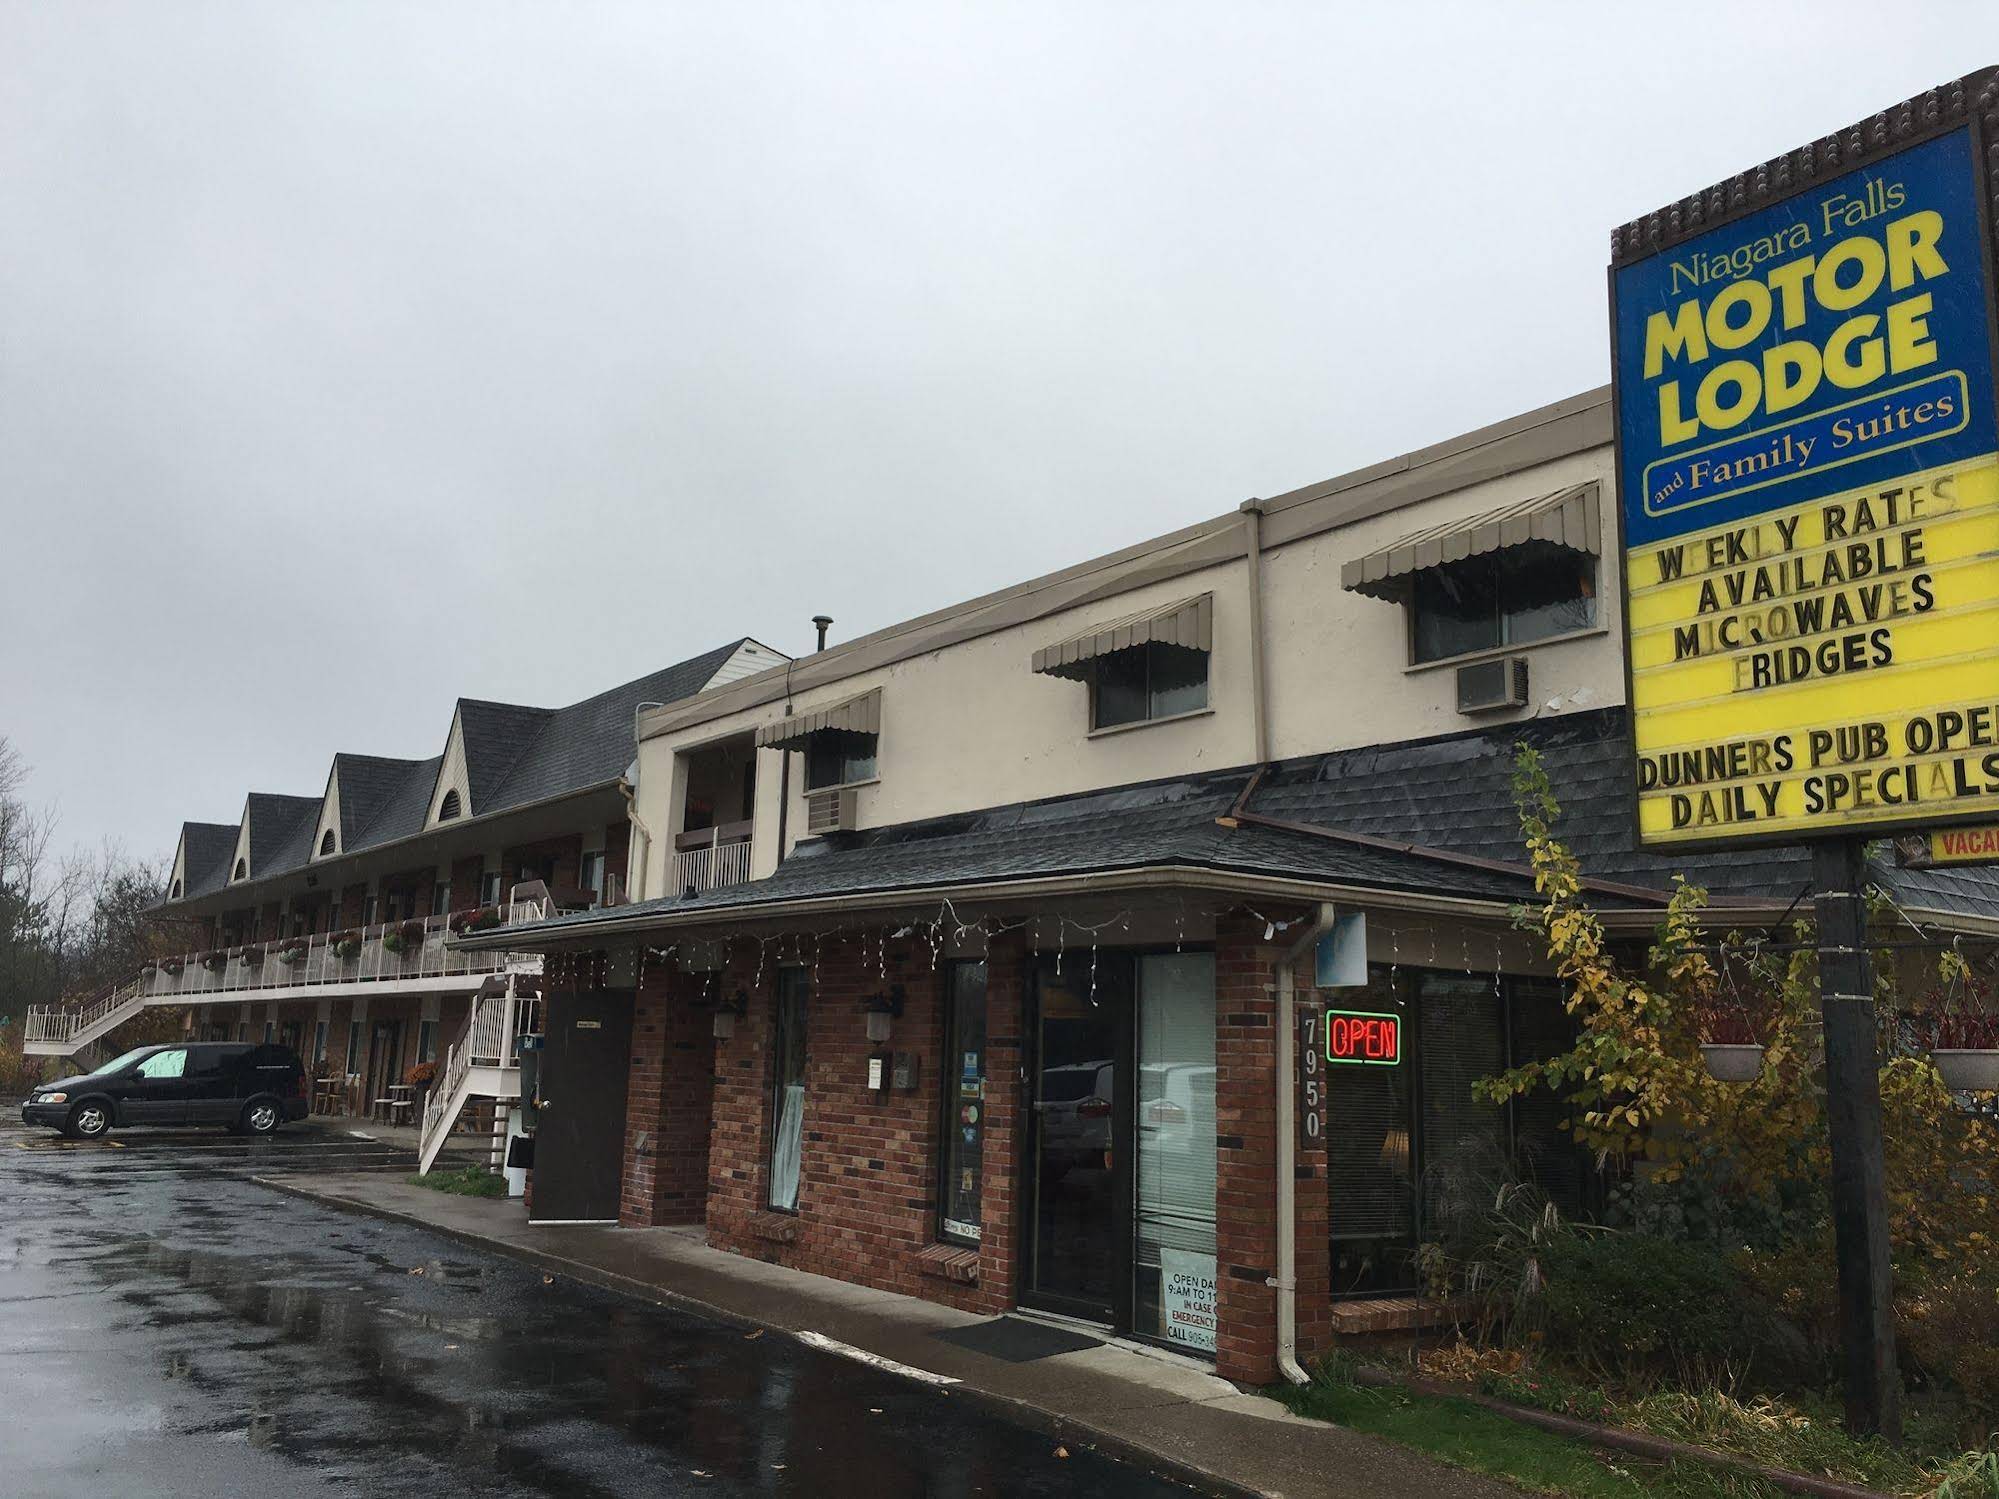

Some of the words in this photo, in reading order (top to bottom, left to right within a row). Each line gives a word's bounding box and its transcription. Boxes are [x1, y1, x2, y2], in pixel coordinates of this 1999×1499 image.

[1670, 220, 1811, 296] Niagara
[1820, 176, 1909, 239] Falls
[1643, 210, 1950, 380] MOTOR
[1658, 291, 1939, 448] LODGE
[1652, 471, 1685, 504] and
[1687, 434, 1817, 491] Family
[1831, 394, 1955, 450] Suites
[1822, 475, 1957, 542] RATES
[1697, 528, 1926, 615] AVAILABLE
[1673, 573, 1934, 661] MICROWAVES
[1732, 628, 1893, 691] FRIDGES
[1637, 735, 1794, 791] DUNNERS
[1808, 722, 1889, 767] PUB
[1905, 704, 1999, 754] OPE
[1671, 781, 1782, 829] DAILY
[1803, 753, 1999, 814] SPECIALS
[1941, 829, 1999, 855] VACA
[1331, 1017, 1396, 1058] OPEN
[1304, 1018, 1320, 1138] 7950
[1173, 1273, 1199, 1287] OPEN
[1193, 1288, 1205, 1300] TO
[1193, 1301, 1212, 1314] CASE
[1167, 1325, 1187, 1341] CALL
[1172, 1310, 1214, 1327] EMERGENCY
